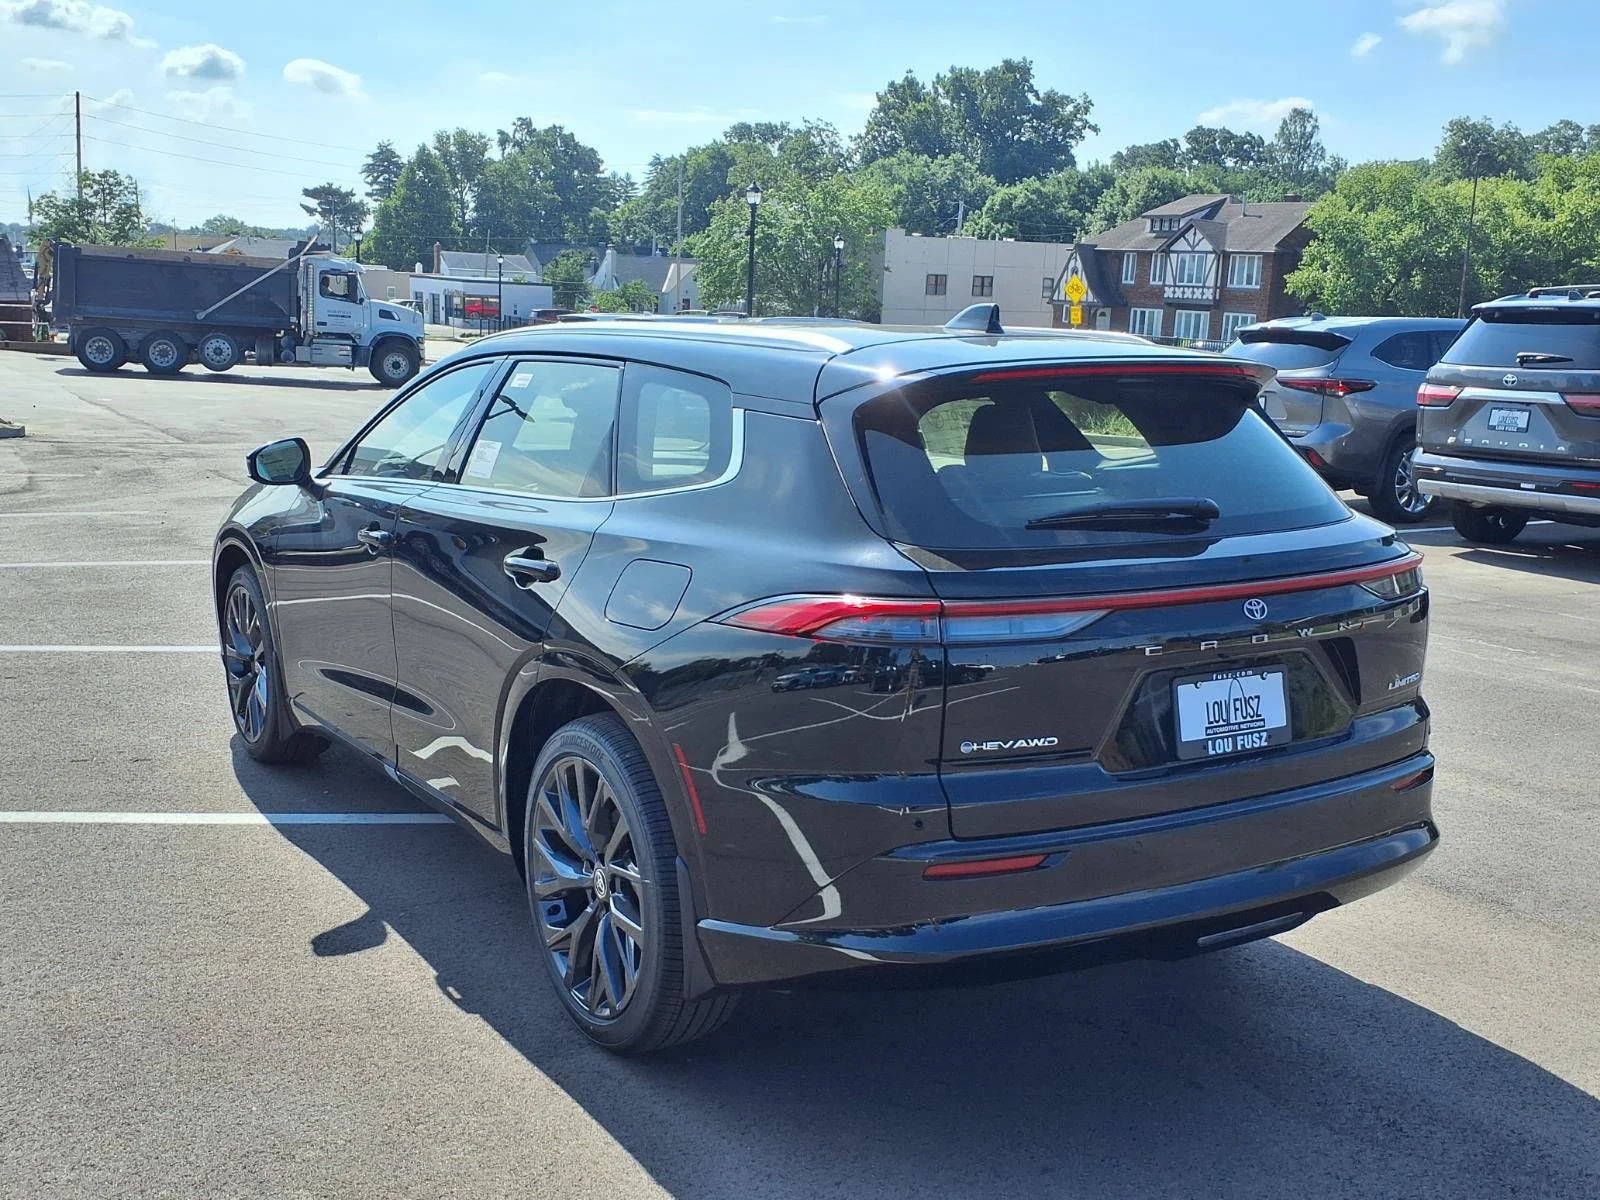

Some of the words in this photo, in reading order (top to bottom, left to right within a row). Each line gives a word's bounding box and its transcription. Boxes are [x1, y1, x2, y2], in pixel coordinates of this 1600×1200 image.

[1213, 669, 1253, 680] fusz.com
[1206, 699, 1228, 725] LOU
[1233, 695, 1262, 721] FUSZ
[1206, 724, 1239, 735] AUTOMOTIVE
[1240, 719, 1265, 730] NETWORK
[1207, 737, 1233, 755] LOU
[1237, 731, 1268, 750] FUSZ
